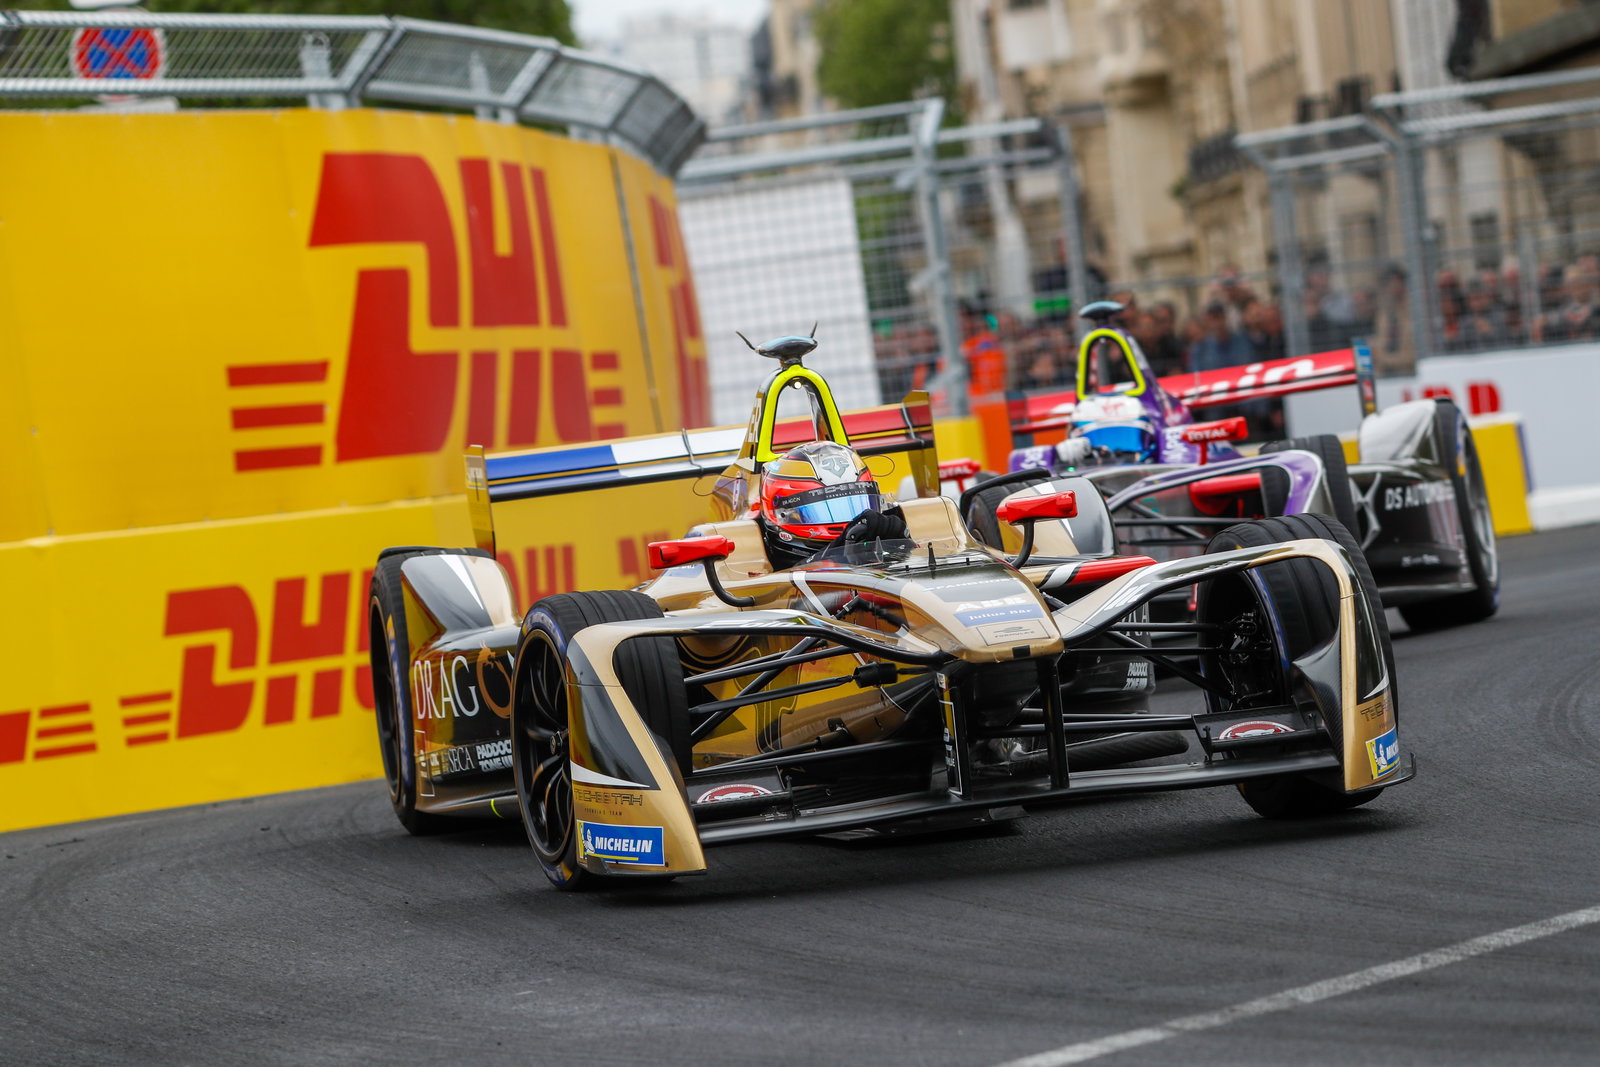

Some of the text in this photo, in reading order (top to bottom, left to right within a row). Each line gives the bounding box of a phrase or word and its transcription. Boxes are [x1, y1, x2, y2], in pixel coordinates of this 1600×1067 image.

[307, 151, 593, 464] DHL
[1186, 427, 1230, 441] TOTAL
[939, 464, 972, 479] OTAL
[1385, 487, 1403, 510] DS
[780, 532, 791, 540] BELL
[968, 610, 1005, 621] Julius
[476, 739, 512, 760] PADDOC
[574, 788, 644, 806] TECHEETAH
[595, 836, 653, 853] MICHELIN
